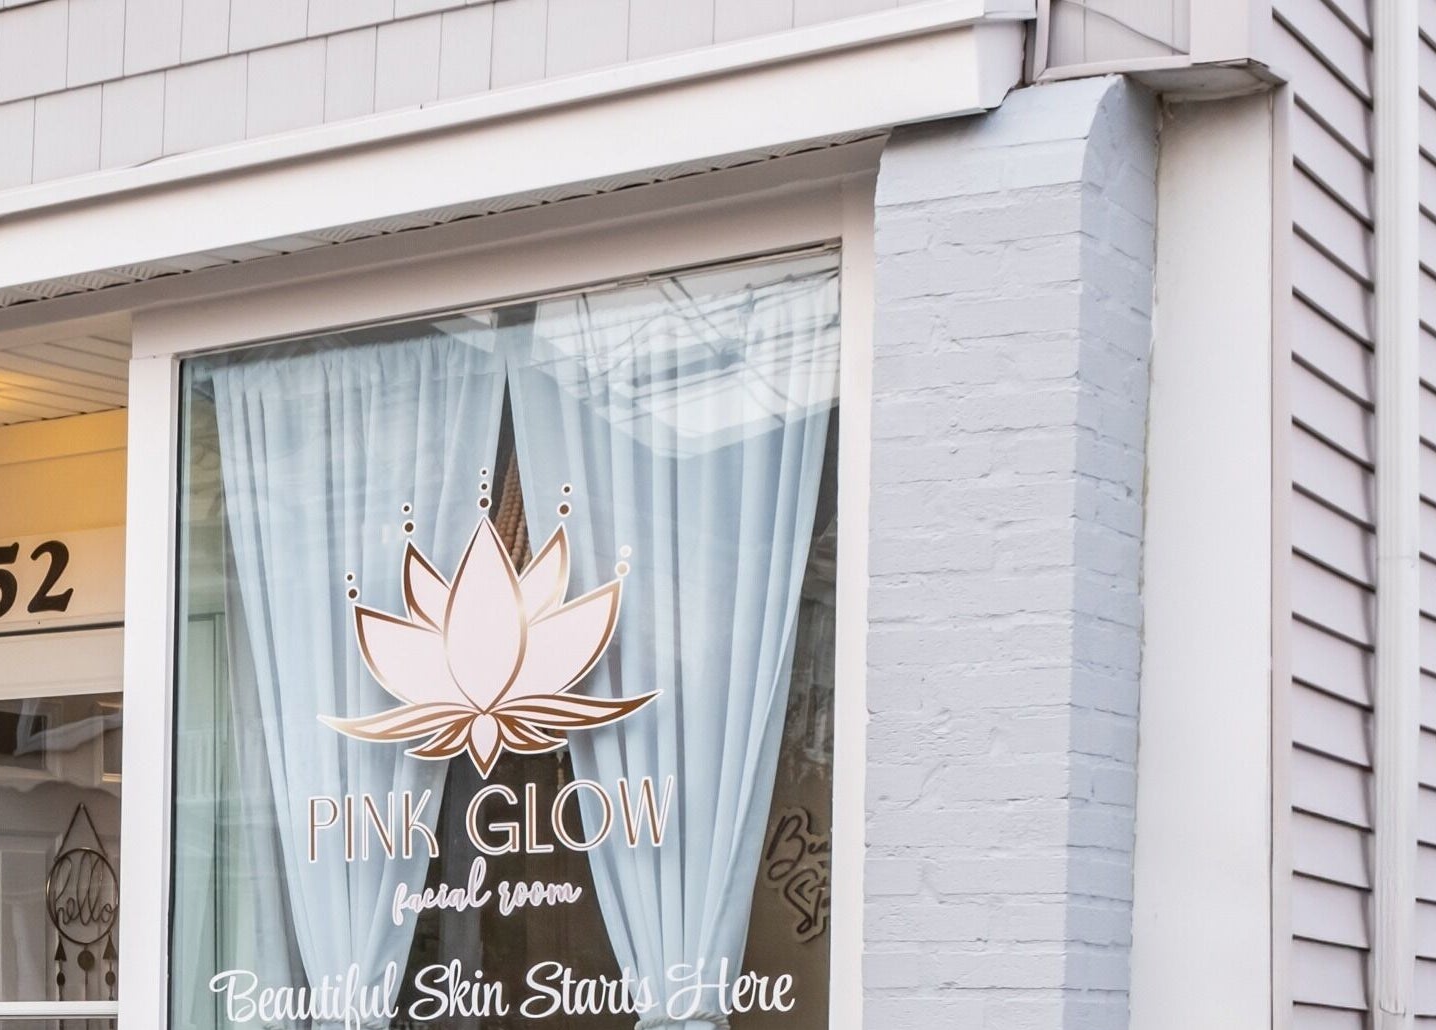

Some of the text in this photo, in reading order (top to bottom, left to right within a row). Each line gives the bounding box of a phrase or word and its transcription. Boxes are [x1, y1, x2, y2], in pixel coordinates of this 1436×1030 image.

[306, 775, 675, 864] PINK GLOW
[392, 855, 582, 927] facial room
[409, 959, 509, 1020] Skin
[520, 960, 660, 1020] Starts
[666, 957, 795, 1022] Here
